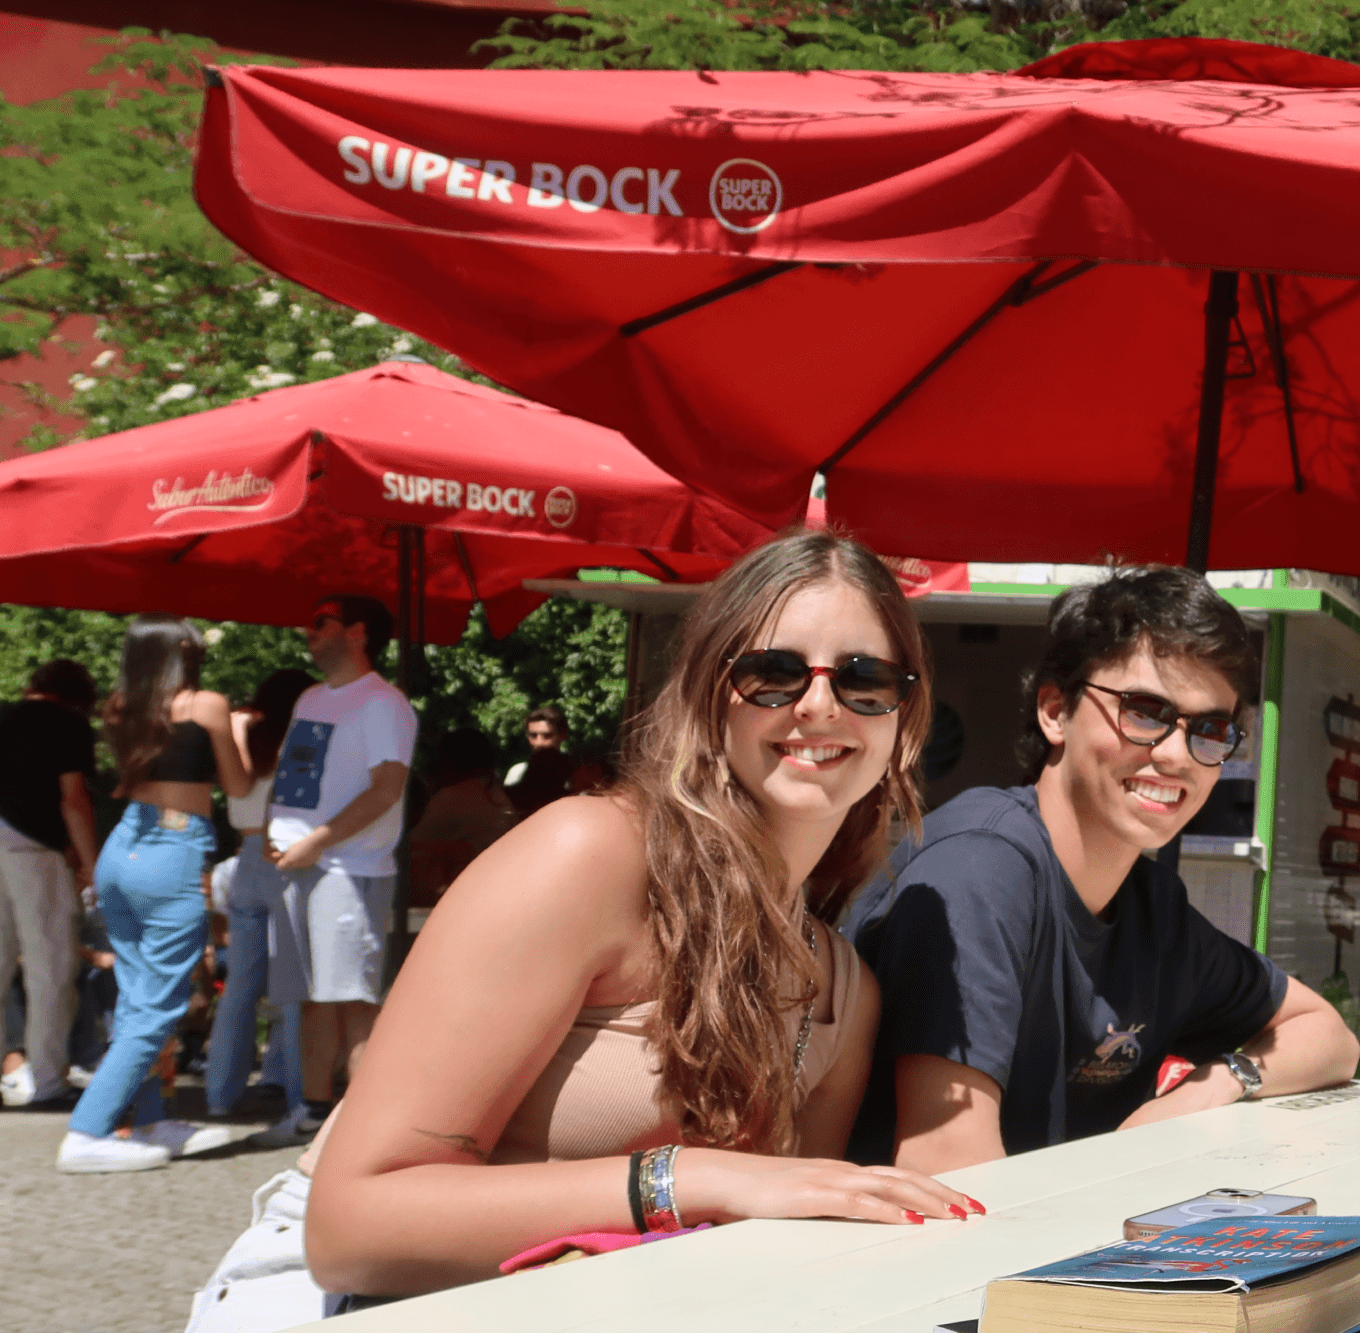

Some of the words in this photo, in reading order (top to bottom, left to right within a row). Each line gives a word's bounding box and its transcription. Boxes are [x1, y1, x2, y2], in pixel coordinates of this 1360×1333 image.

[337, 135, 514, 203] SUPER
[526, 162, 684, 217] BOCK
[719, 177, 771, 195] SUPER
[721, 194, 769, 211] BOCK
[382, 471, 462, 508] SUPER
[466, 482, 535, 517] BOCK
[1213, 1225, 1325, 1240] KATE
[1113, 1243, 1330, 1259] TRANSCRIPTION
[1132, 1234, 1357, 1251] ATKINSON
